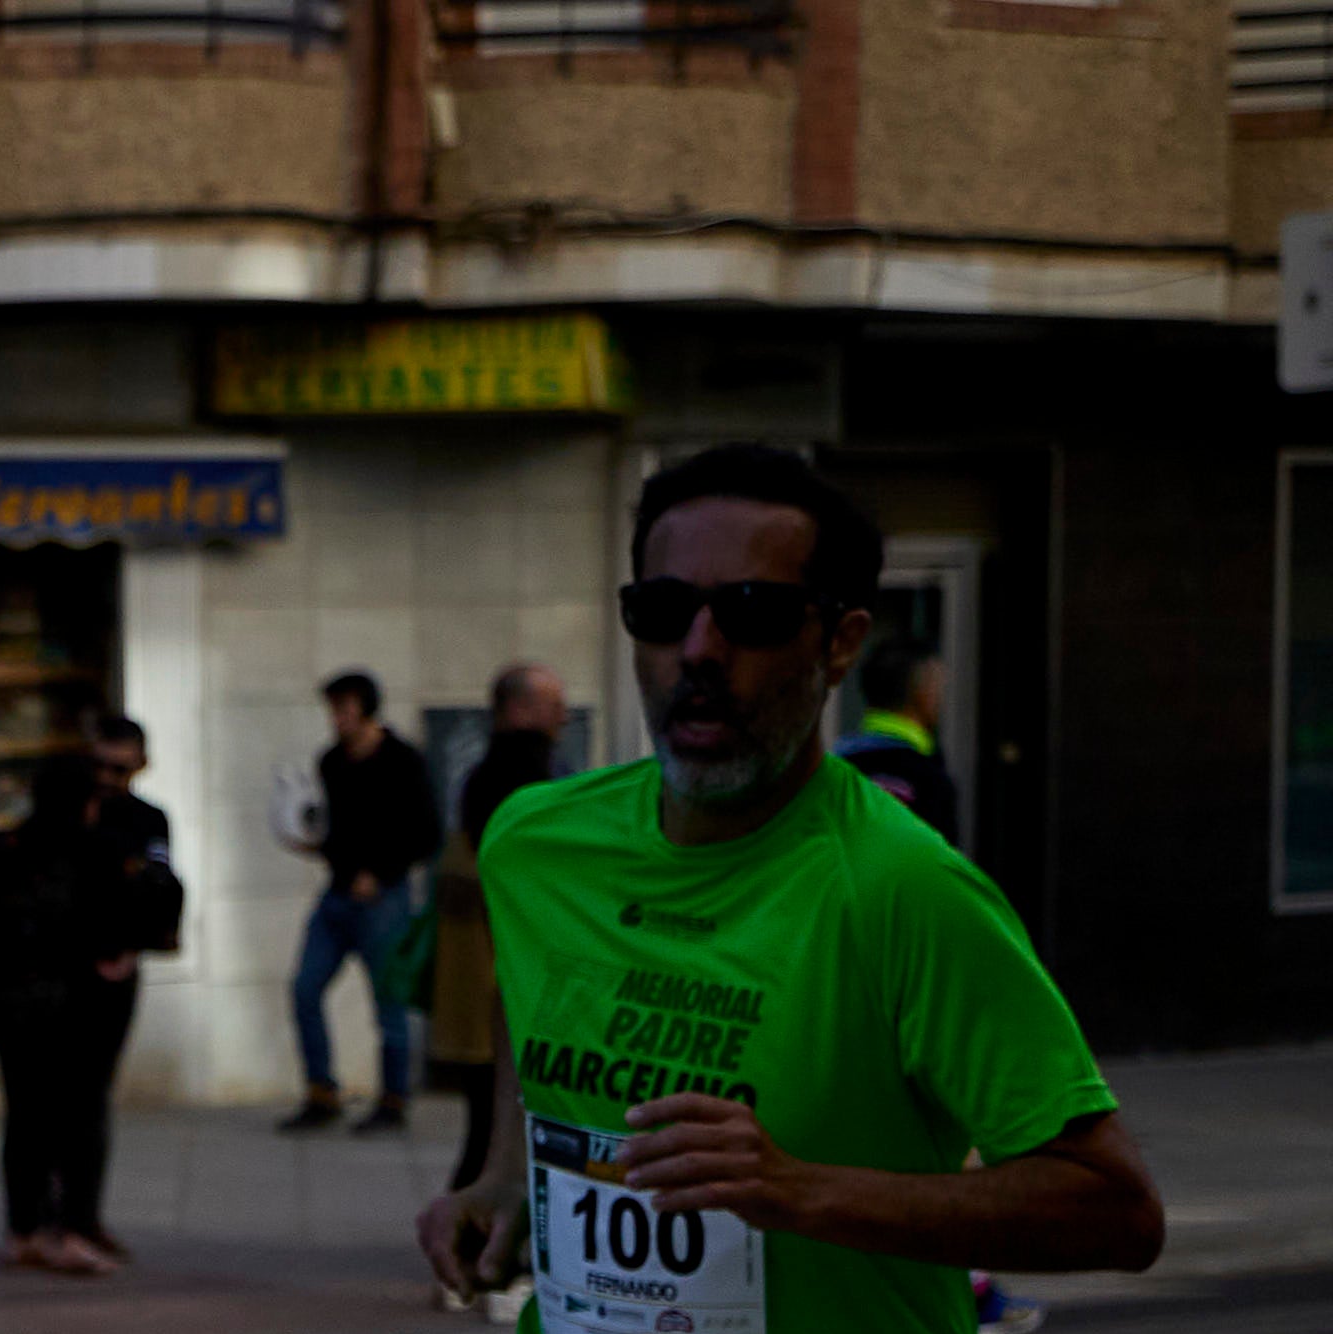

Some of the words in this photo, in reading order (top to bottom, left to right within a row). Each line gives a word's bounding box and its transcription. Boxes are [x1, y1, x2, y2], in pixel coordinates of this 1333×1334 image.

[615, 968, 766, 1024] MEMORIAL
[604, 1008, 751, 1071] PADRE
[573, 1187, 705, 1276] 100
[586, 1271, 679, 1301] FERNANDO
